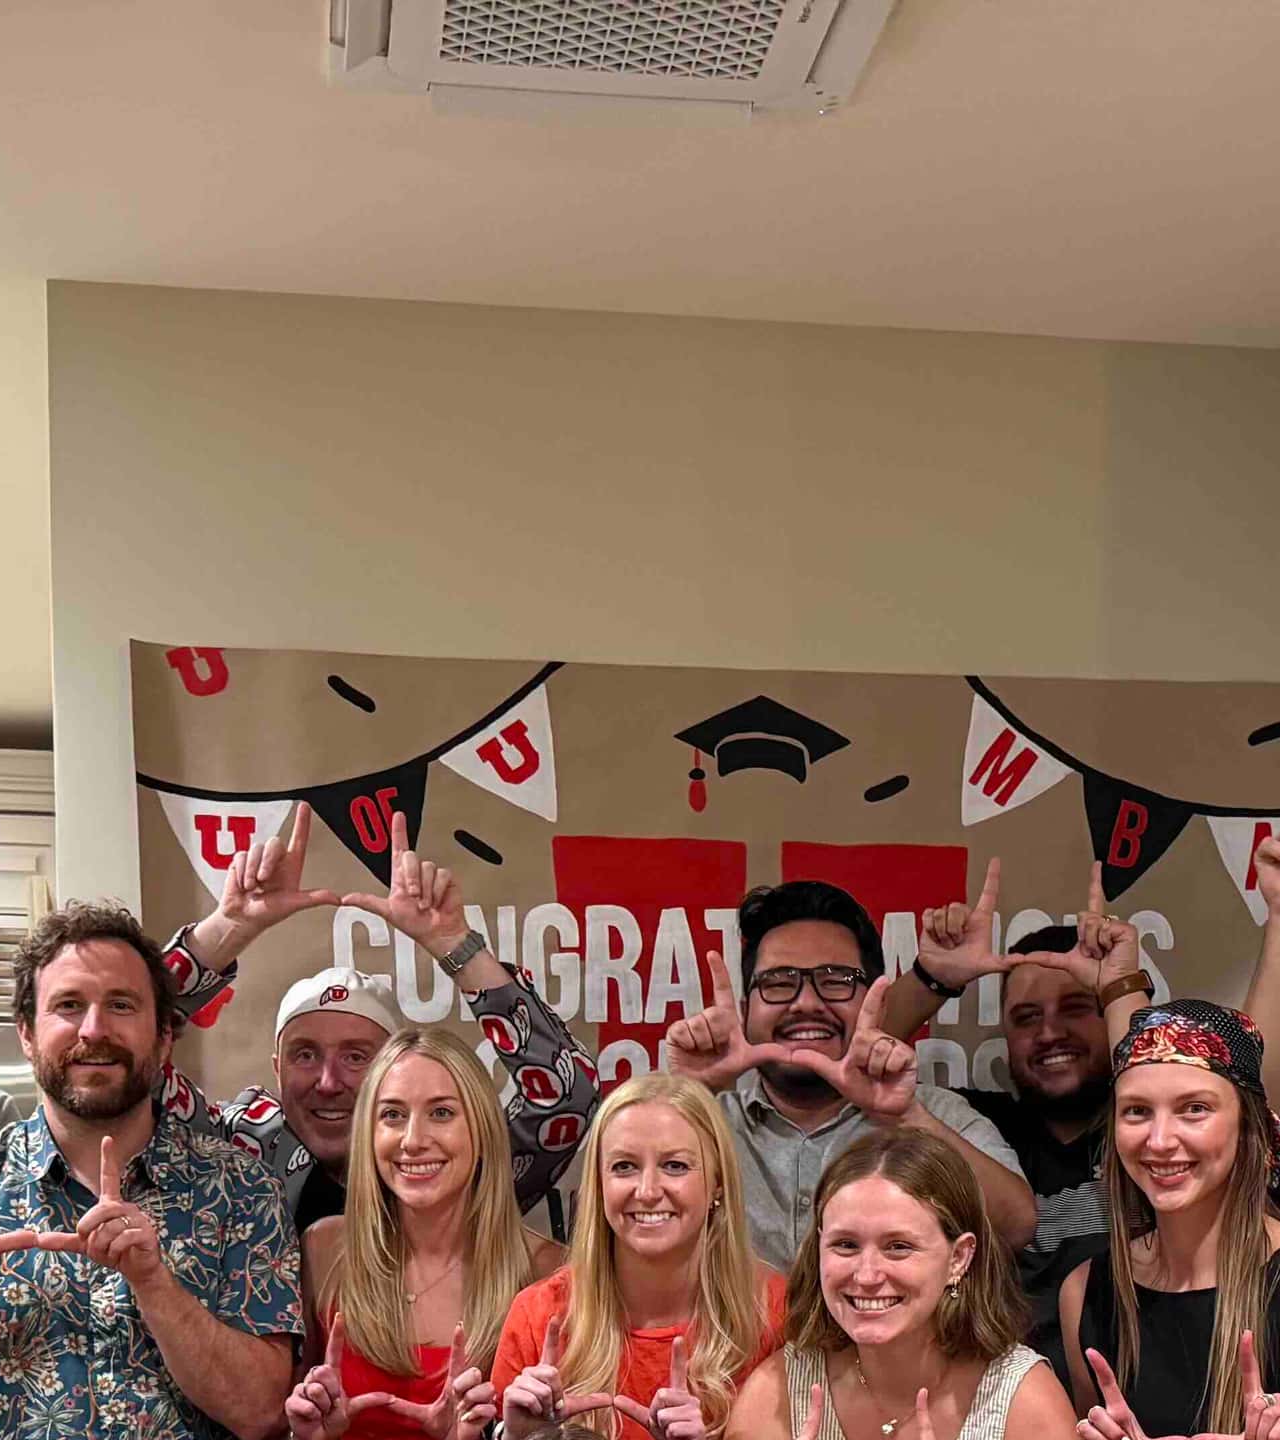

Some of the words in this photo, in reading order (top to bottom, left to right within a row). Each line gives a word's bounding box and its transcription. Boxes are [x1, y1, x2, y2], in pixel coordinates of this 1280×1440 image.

[166, 647, 229, 696] U
[194, 814, 256, 870] U
[475, 719, 540, 785] U
[968, 727, 1039, 807] M
[1107, 799, 1149, 868] B
